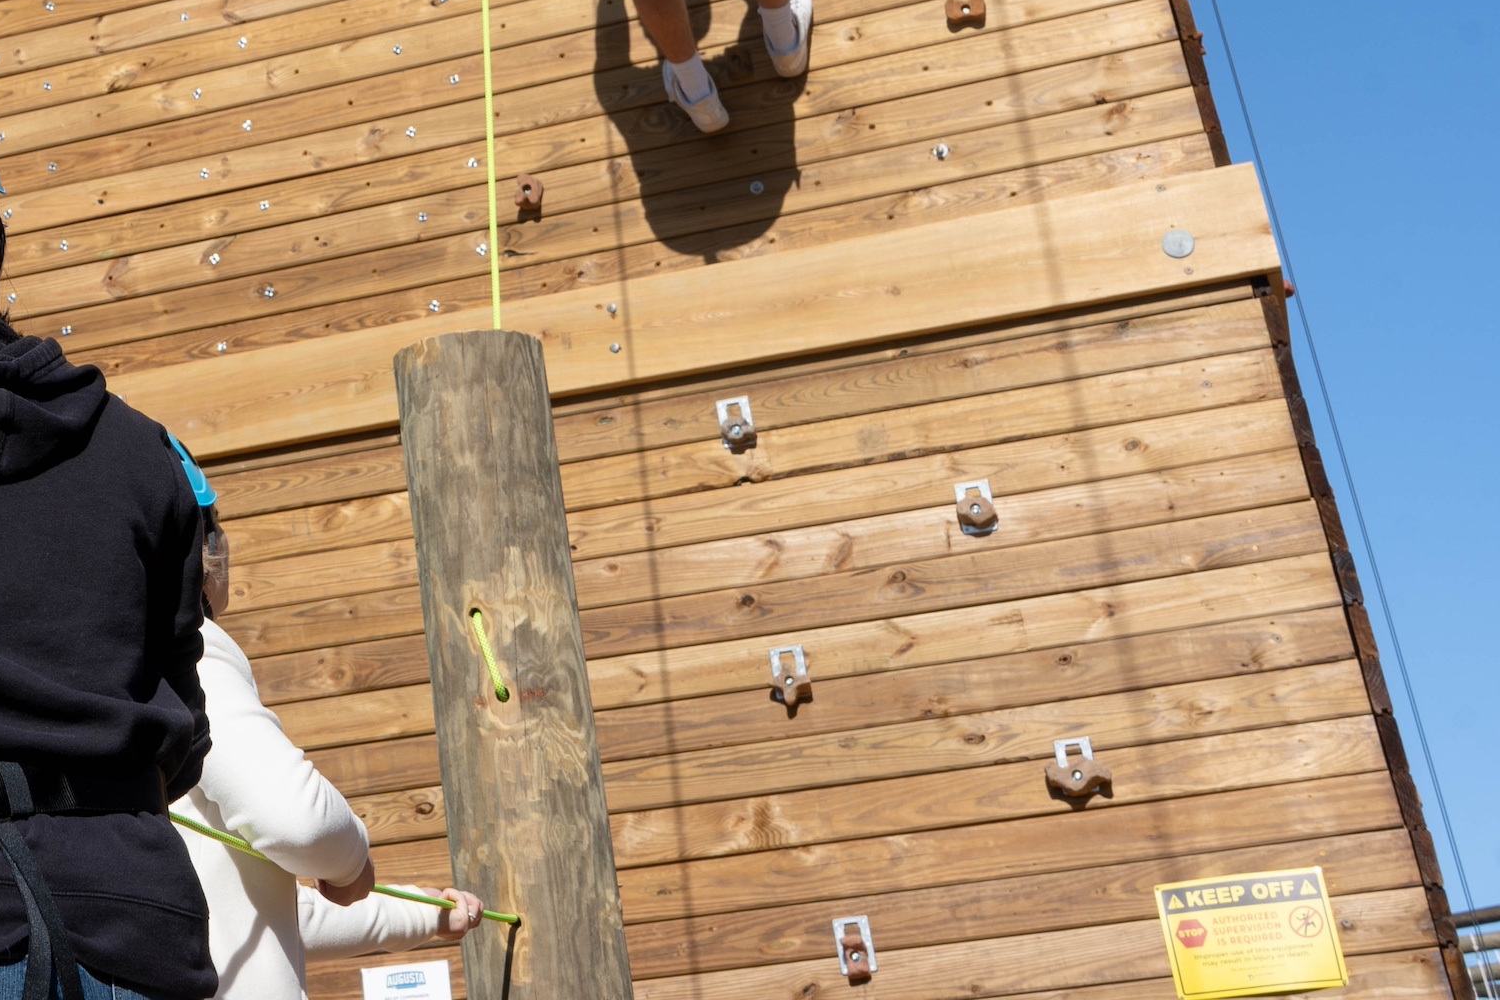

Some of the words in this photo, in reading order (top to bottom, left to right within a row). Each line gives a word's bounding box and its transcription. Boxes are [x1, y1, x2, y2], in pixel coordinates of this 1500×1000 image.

[1185, 885, 1245, 908] KEEP
[1251, 880, 1295, 900] OFF
[1212, 911, 1278, 925] AUTHORIZED
[1178, 928, 1205, 939] STOP
[1212, 922, 1282, 936] SUPERVISION
[1217, 938, 1228, 947] IS
[1230, 932, 1286, 945] REQUIRED.
[1194, 951, 1229, 961] Improper
[1272, 943, 1314, 953] equipment
[1202, 960, 1219, 968] may
[1220, 957, 1242, 965] result
[1252, 954, 1276, 963] injury
[387, 971, 426, 987] AUGUSTA
